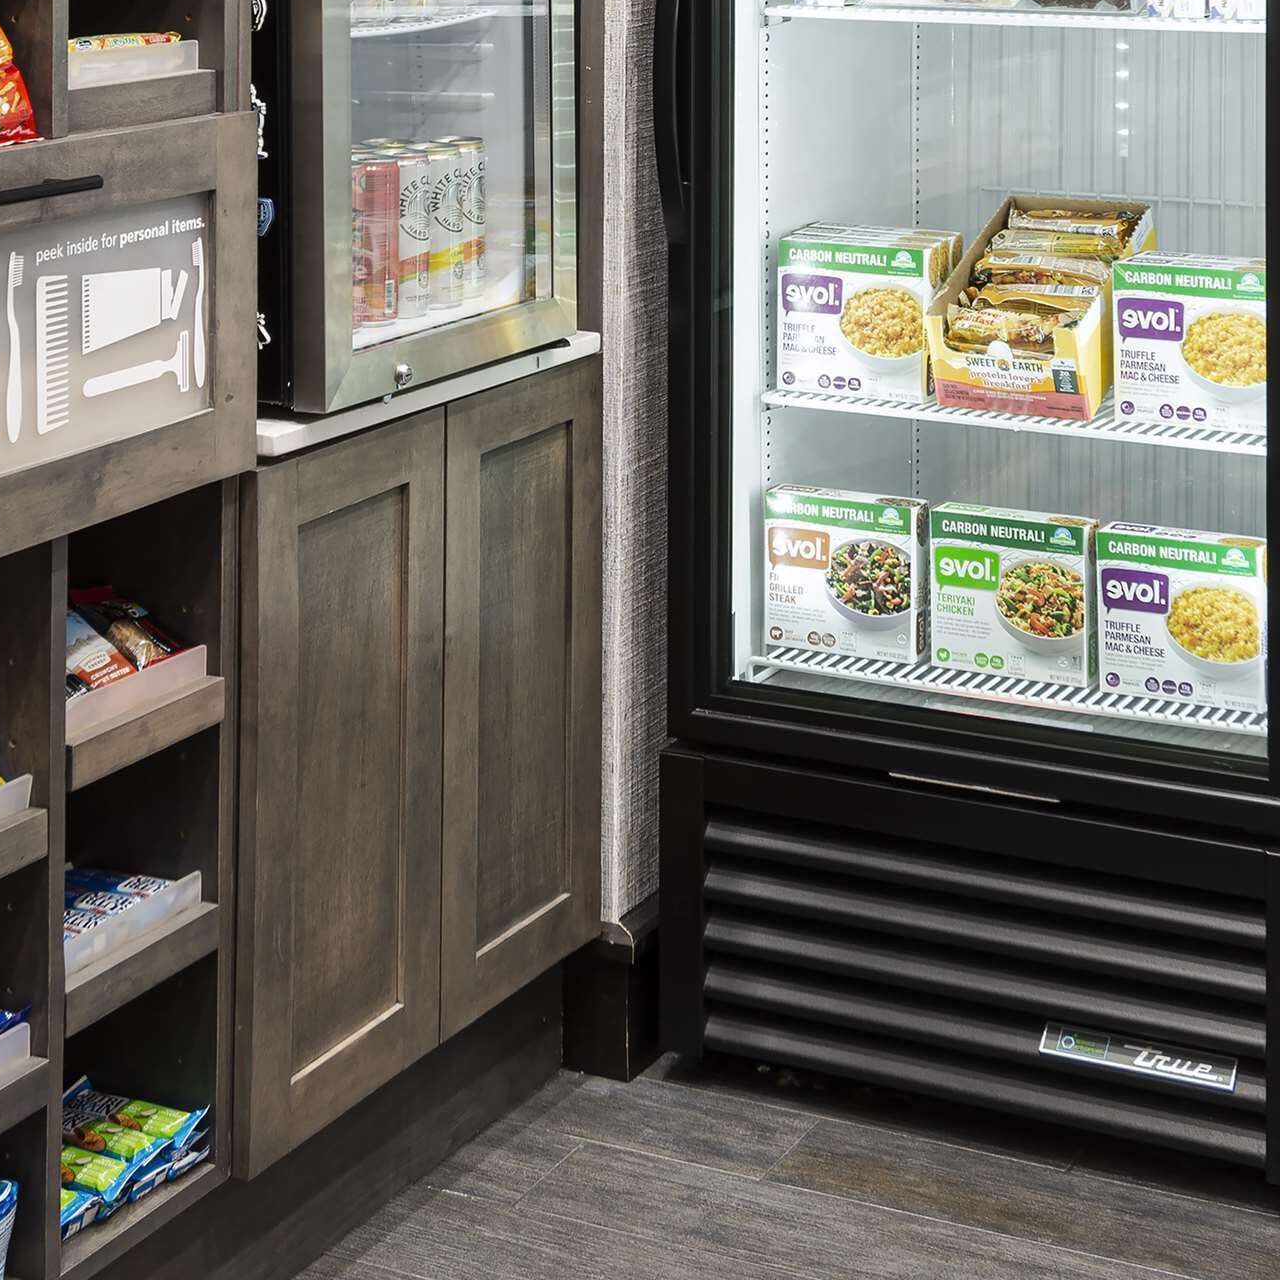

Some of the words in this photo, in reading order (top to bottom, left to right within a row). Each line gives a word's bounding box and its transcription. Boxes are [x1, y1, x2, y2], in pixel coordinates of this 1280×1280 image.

[431, 173, 451, 212] WHITE
[36, 245, 63, 266] peek
[66, 237, 99, 256] inside
[101, 233, 118, 250] for
[119, 222, 170, 249] personal
[171, 216, 206, 235] items.
[789, 248, 833, 263] CARBON
[835, 251, 887, 267] NEUTRAL!
[1120, 349, 1156, 360] TRUFFLE
[965, 356, 996, 369] SWEET
[1012, 361, 1043, 373] EARTH
[1120, 359, 1166, 372] PARMESAN
[1120, 371, 1139, 381] MAC
[1140, 373, 1147, 381] &
[1148, 373, 1180, 384] CHEESE
[942, 520, 987, 535] CARBON
[990, 528, 1045, 544] NEUTRAL!
[1108, 541, 1156, 557] CARBON
[1159, 546, 1217, 564] NEUTRAL!
[936, 593, 976, 606] TERIYAKI
[936, 603, 975, 616] CHICKEN
[1105, 620, 1141, 633] TRUFFLE
[1105, 631, 1151, 645] PARMESAN
[1105, 642, 1124, 652] MAC
[1125, 644, 1132, 654] &
[1133, 645, 1165, 657] CHEESE
